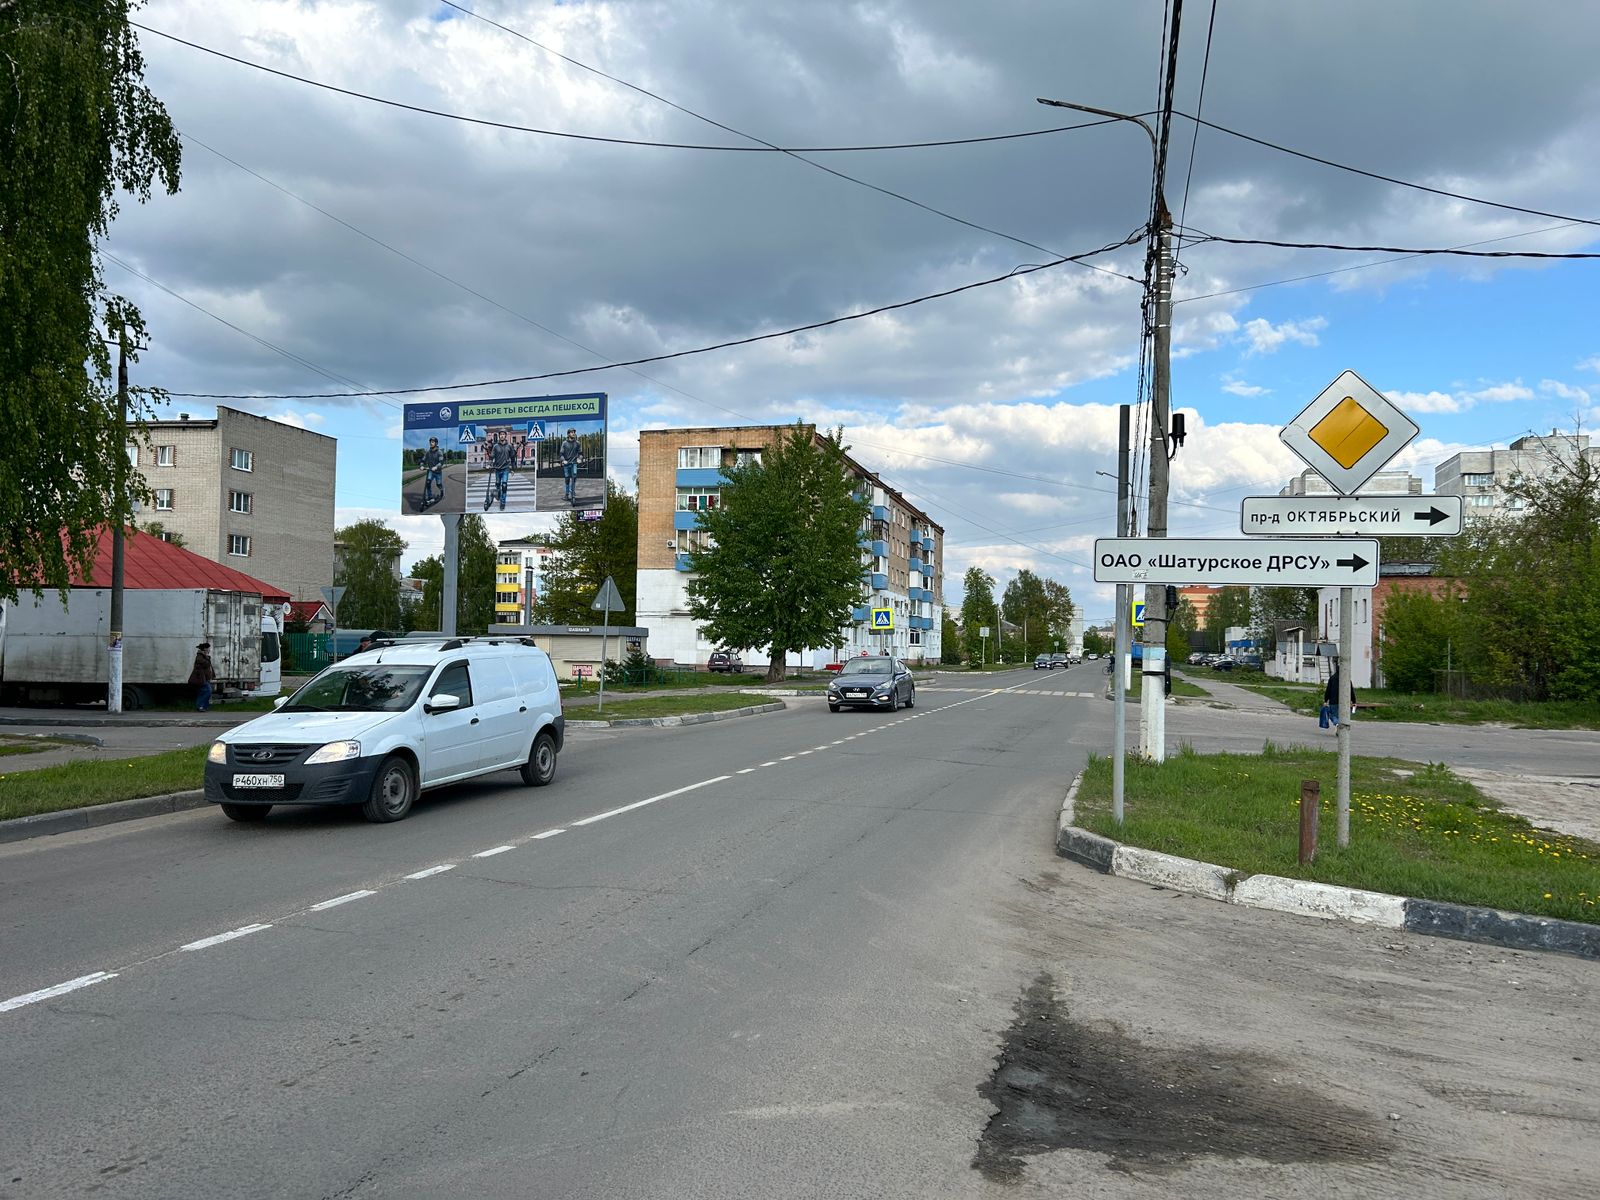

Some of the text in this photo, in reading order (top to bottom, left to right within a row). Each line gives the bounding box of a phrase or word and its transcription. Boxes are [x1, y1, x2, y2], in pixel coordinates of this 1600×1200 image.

[476, 407, 501, 416] ЗЕБРЕ
[504, 406, 516, 414] ТЫ
[518, 404, 550, 413] ВСЕГДА
[552, 402, 595, 412] ПЕШЕХОД
[1250, 508, 1401, 525] пр-д ОКТЯБРЬСКИЙ
[1101, 554, 1330, 572] ОАО «Шатурское ДРСУ»
